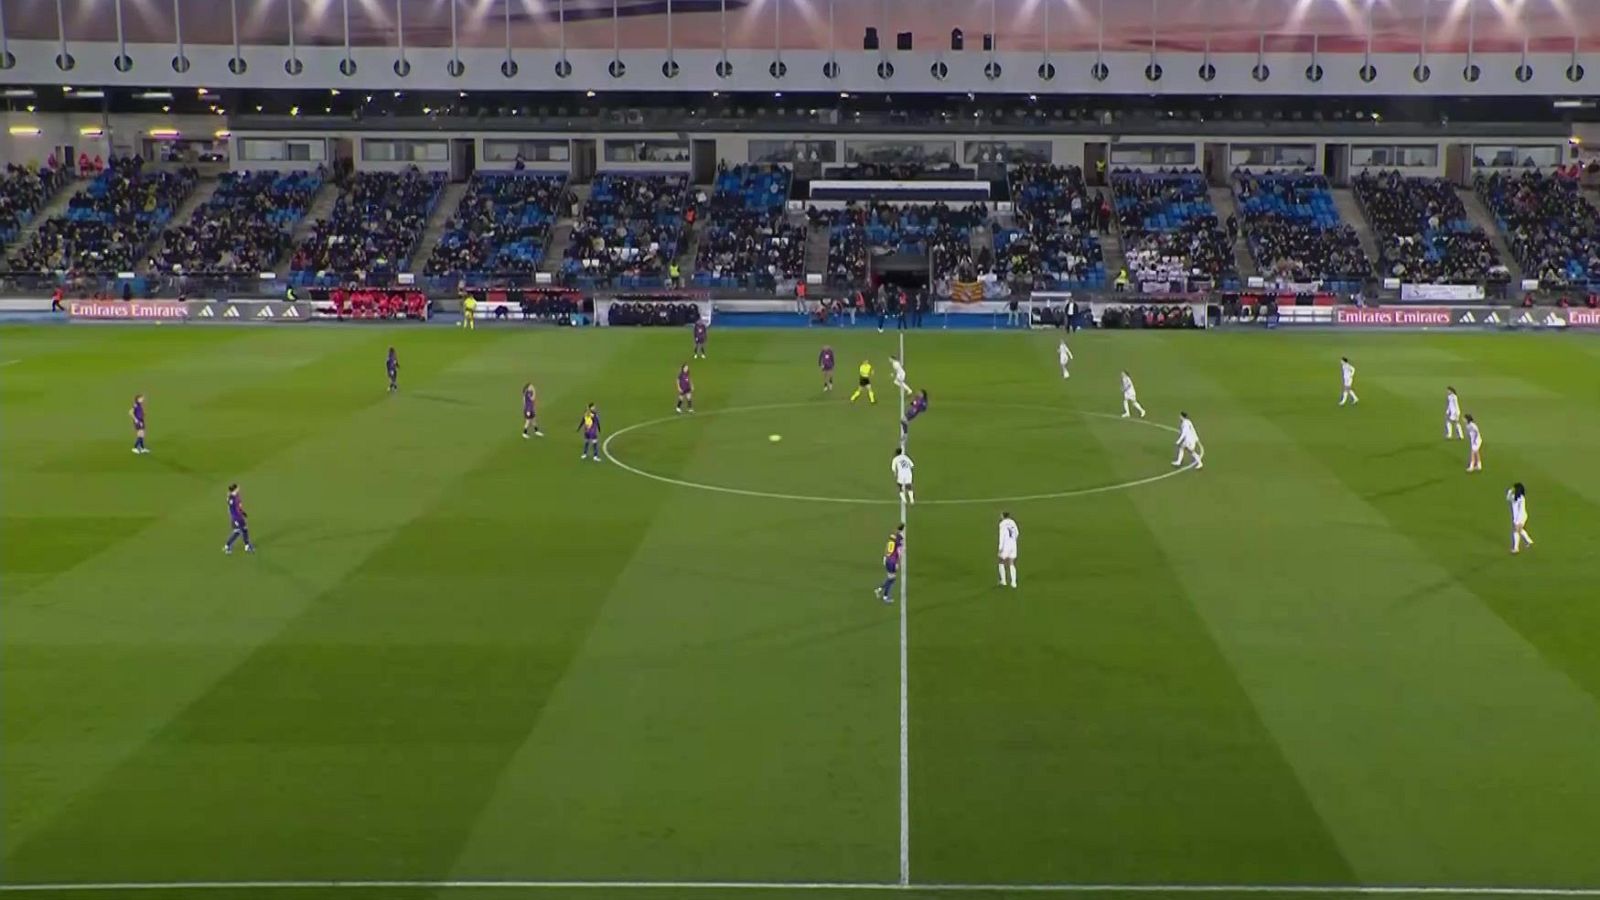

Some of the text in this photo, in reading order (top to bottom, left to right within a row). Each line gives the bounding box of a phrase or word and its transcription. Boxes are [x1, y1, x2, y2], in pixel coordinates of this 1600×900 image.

[70, 303, 189, 317] Emirates Emirates
[1337, 310, 1450, 323] Emirates Emirates
